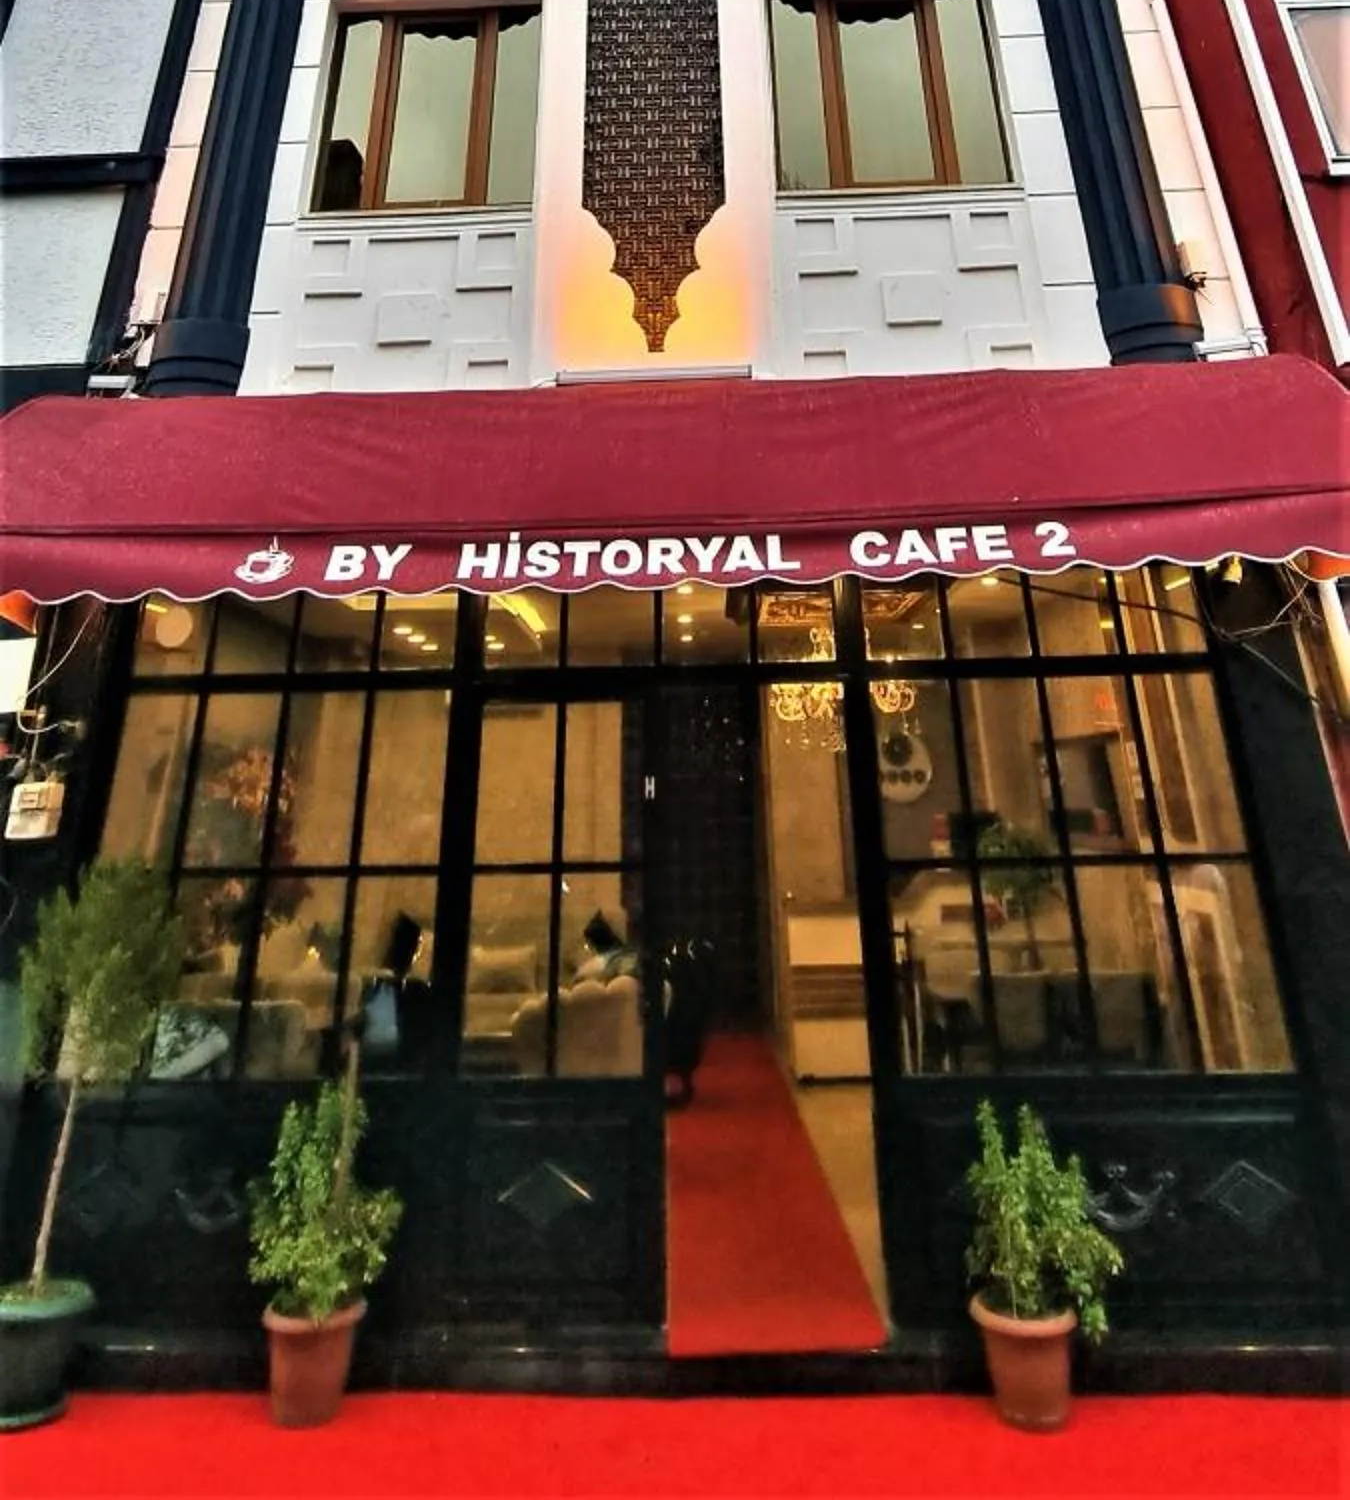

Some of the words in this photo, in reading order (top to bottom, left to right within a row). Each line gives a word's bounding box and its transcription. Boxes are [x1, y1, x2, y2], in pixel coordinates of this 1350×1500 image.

[323, 545, 412, 581] BY
[849, 525, 1015, 567] CAFE
[1035, 521, 1077, 557] 2
